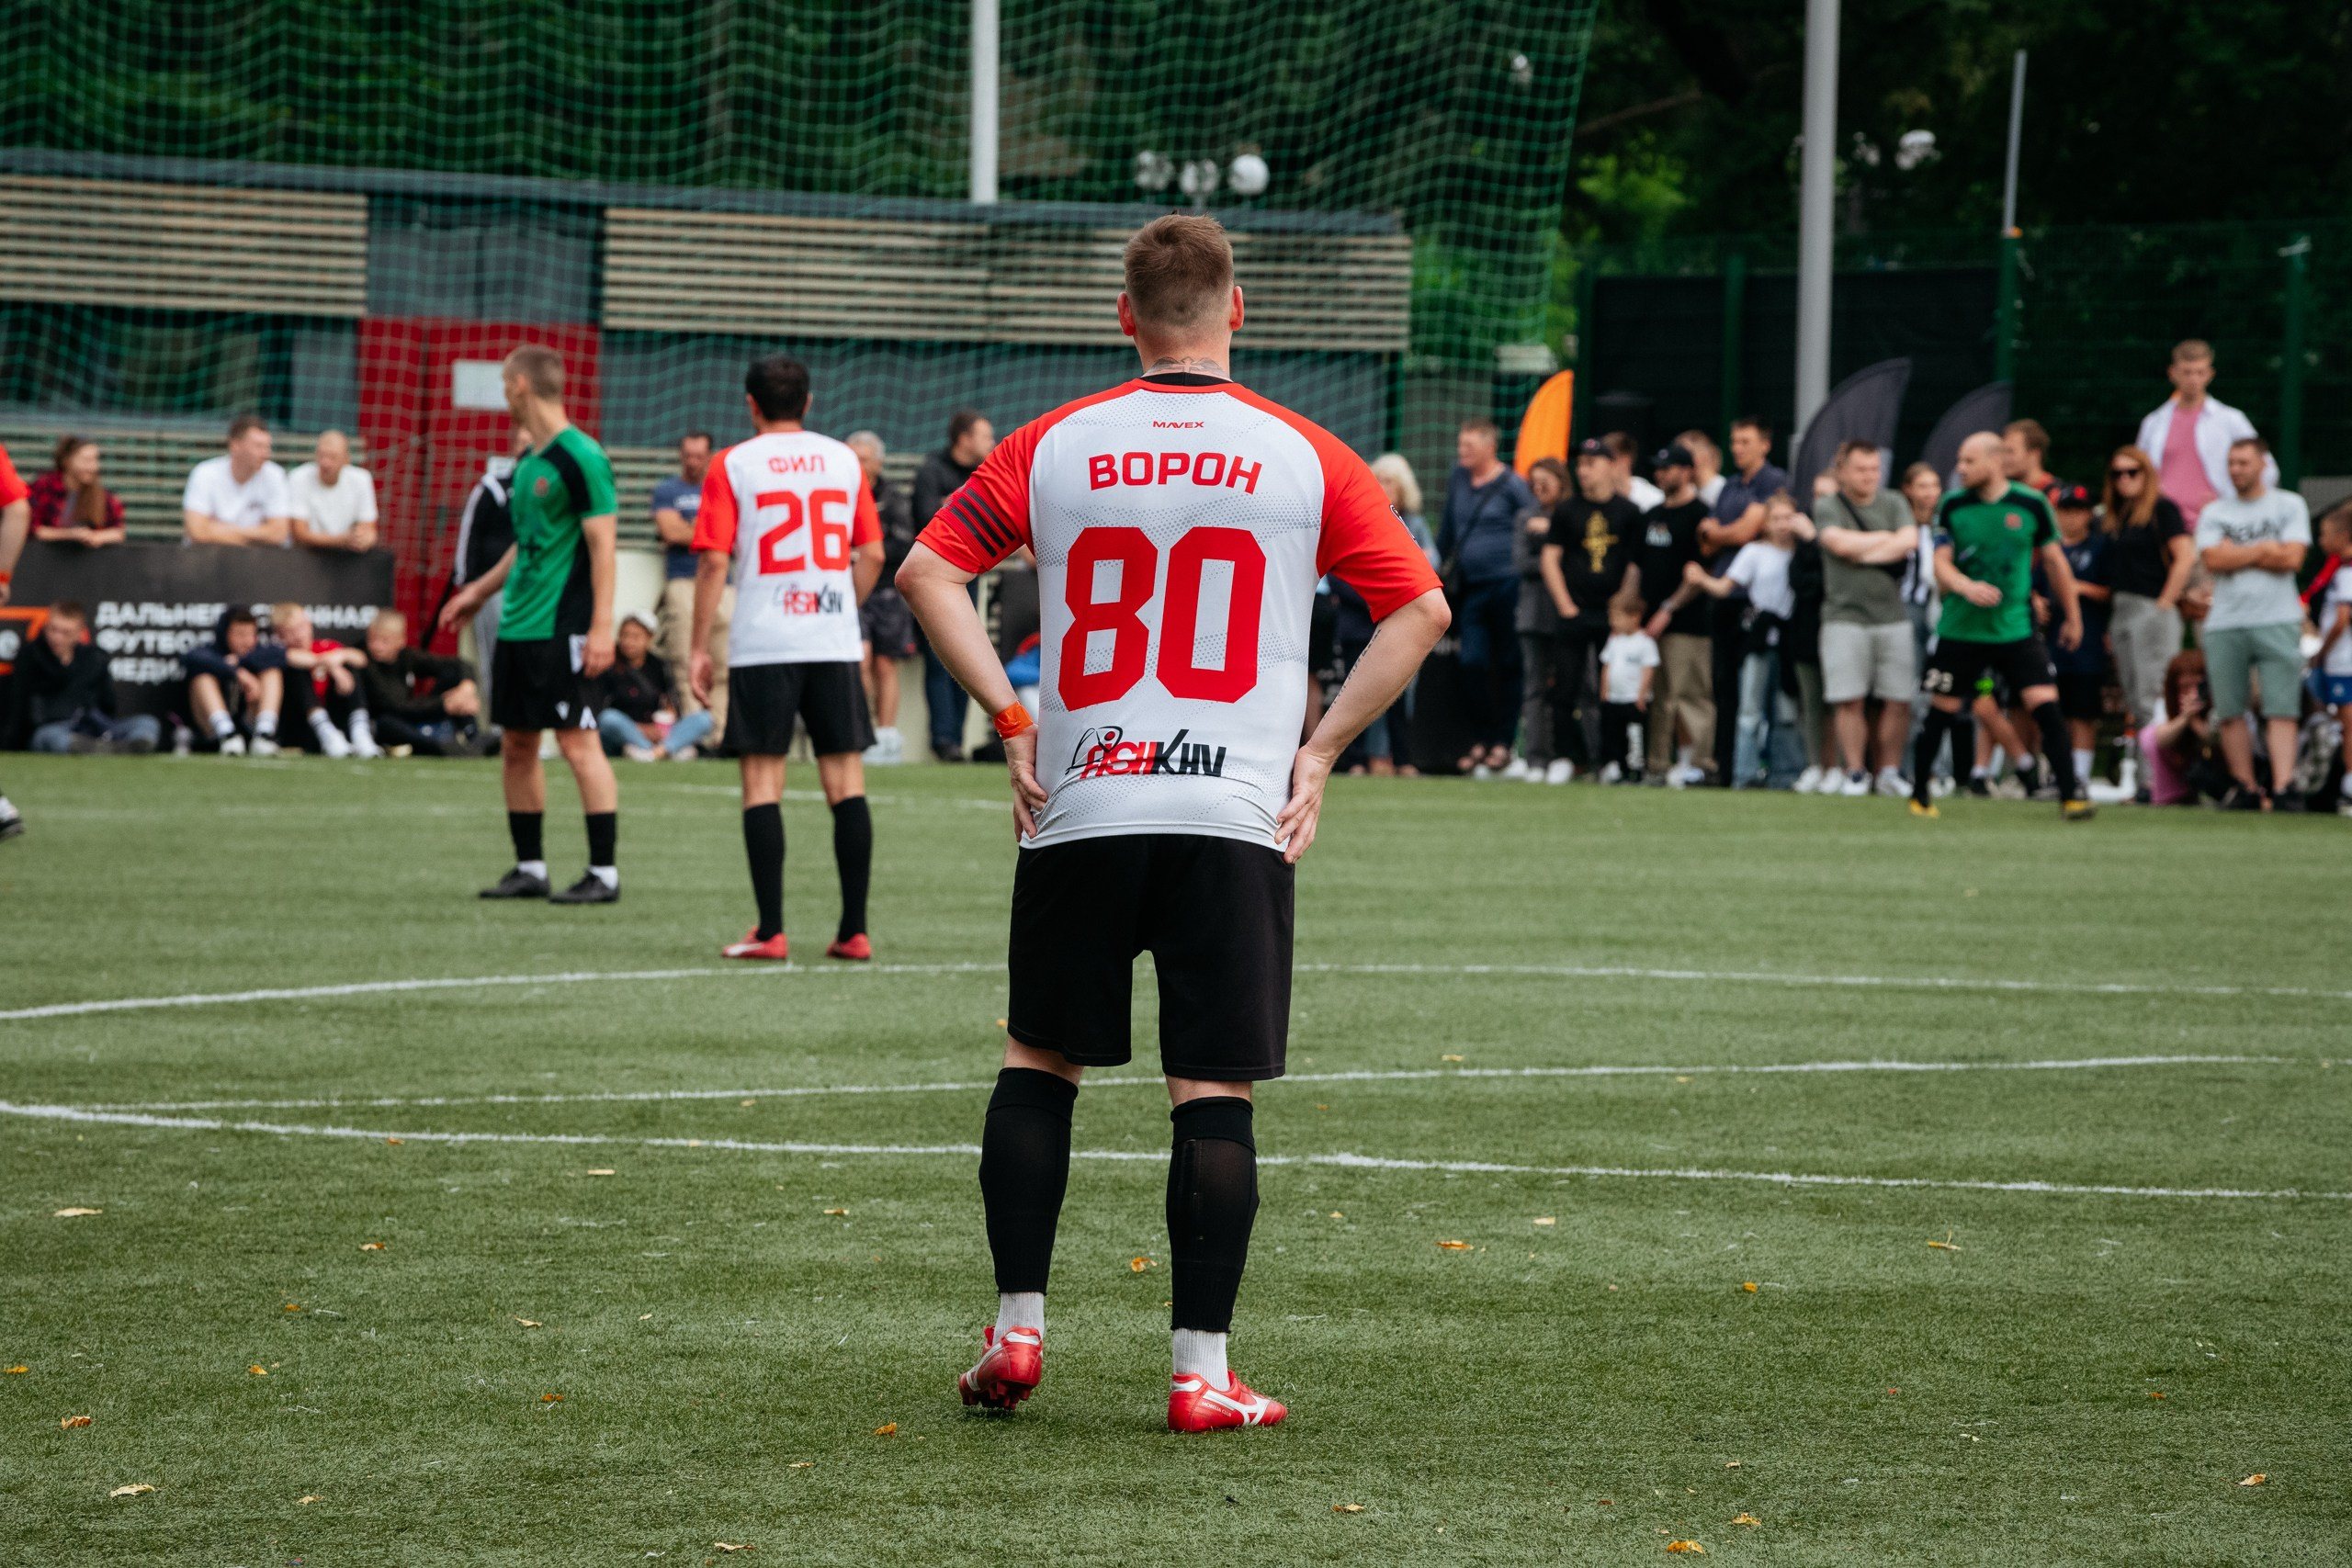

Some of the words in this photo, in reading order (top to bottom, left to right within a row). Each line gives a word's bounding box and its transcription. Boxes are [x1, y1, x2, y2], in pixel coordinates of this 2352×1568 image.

[1153, 420, 1204, 429] MAVEX
[768, 456, 825, 472] ФИЛ
[1089, 451, 1262, 495] ВОРОН
[756, 489, 850, 575] 26
[1058, 526, 1266, 712] 80
